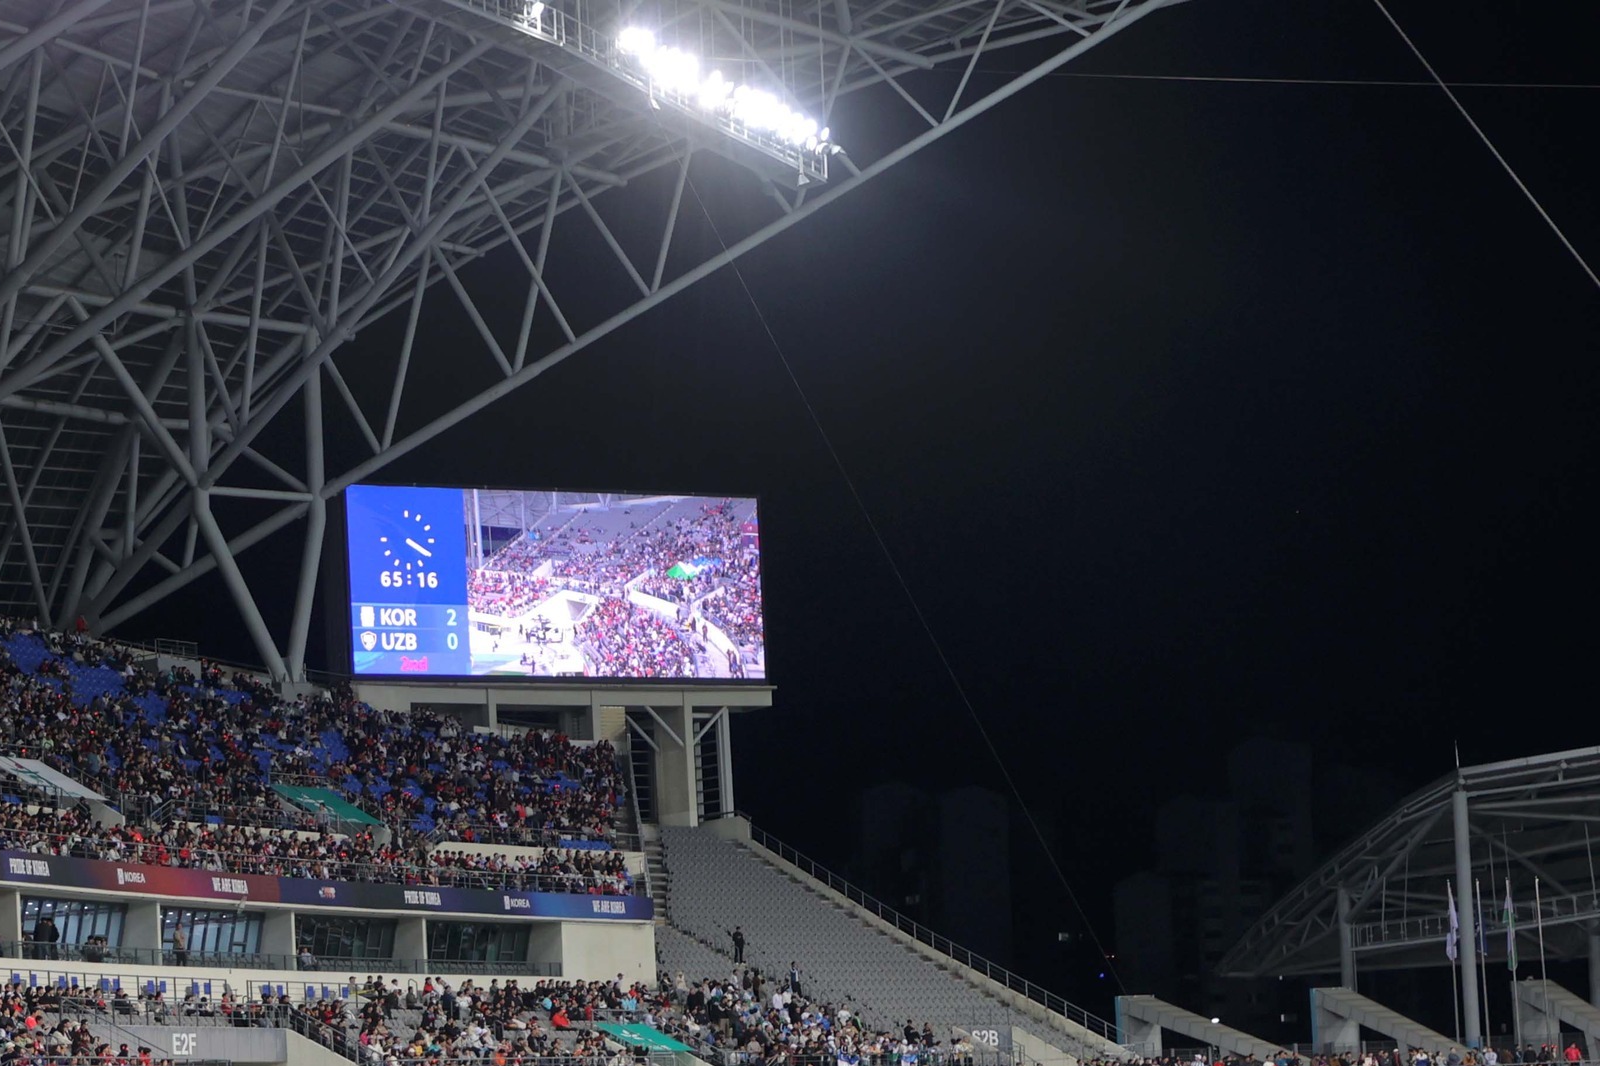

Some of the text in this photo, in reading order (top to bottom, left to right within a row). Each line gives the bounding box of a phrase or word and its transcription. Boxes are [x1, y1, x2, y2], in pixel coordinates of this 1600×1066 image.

[380, 571, 438, 588] 65:16
[380, 608, 457, 626] KOR 2
[381, 633, 458, 650] UZB 0
[400, 656, 428, 671] 2nd
[9, 858, 50, 876] PRIDE OF KOREA
[124, 871, 146, 883] KOREA
[212, 877, 249, 894] WE ARE KOREA
[510, 898, 530, 908] KOREA
[610, 902, 626, 913] KOREA
[172, 1033, 197, 1055] E2F
